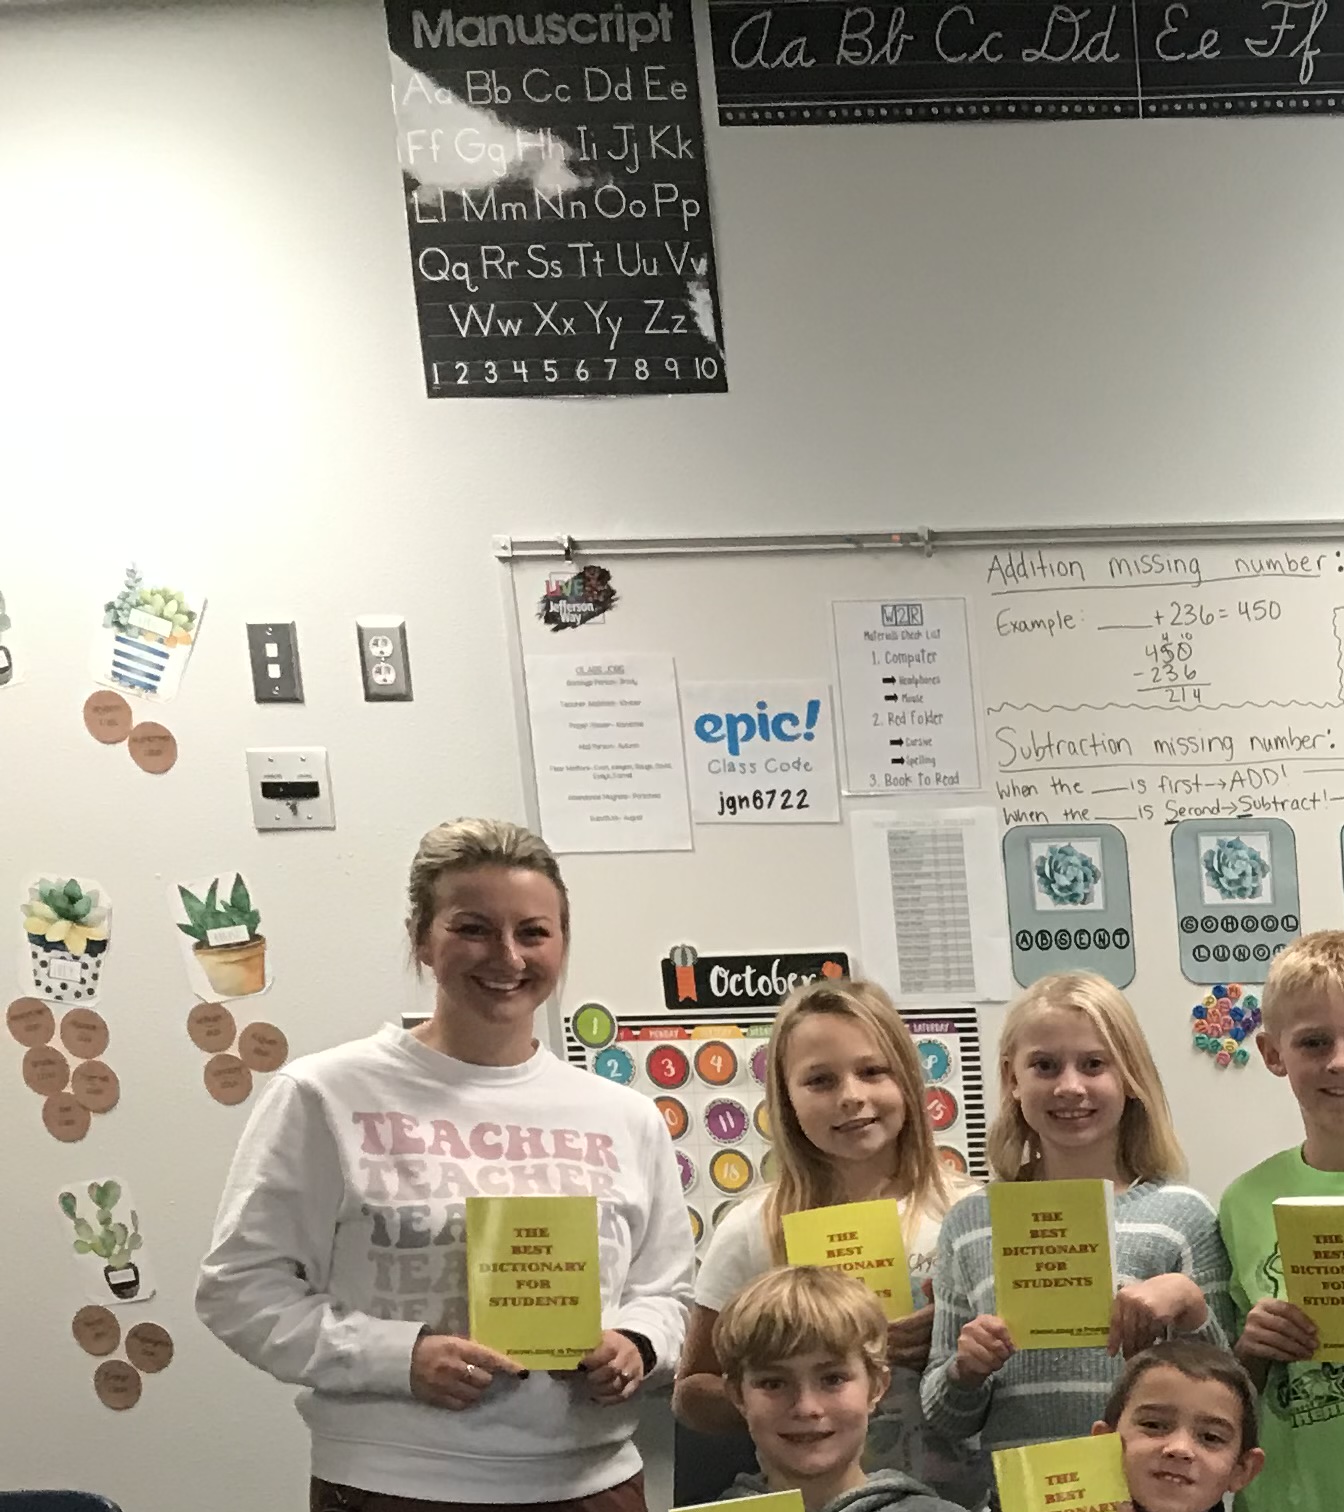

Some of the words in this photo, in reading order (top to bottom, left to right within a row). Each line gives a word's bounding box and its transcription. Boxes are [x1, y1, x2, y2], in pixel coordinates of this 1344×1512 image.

[412, 8, 674, 49] Manuscript
[731, 10, 812, 69] Aa
[836, 8, 914, 66] Bb
[935, 10, 1000, 64] Cc
[1023, 5, 1120, 62] Dd
[418, 247, 478, 291] Qq
[482, 246, 519, 276] Rr
[527, 246, 562, 278] Ss
[569, 244, 604, 275] Tt
[617, 244, 657, 275] Uu
[449, 305, 522, 336] Ww
[534, 302, 576, 336] Xx
[587, 301, 623, 349] Yy
[644, 300, 687, 334] Zz
[987, 551, 1086, 586] Addition
[1109, 553, 1201, 588] missing
[550, 600, 594, 612] Jefferson
[1239, 600, 1281, 621] 450
[560, 612, 581, 624] Way
[872, 651, 880, 665] 1.
[885, 649, 937, 667] Computer
[1166, 688, 1200, 702] 214
[694, 700, 820, 755] epic!
[873, 714, 883, 726] 2.
[888, 712, 906, 726] Red
[996, 726, 1132, 767] Subtraction
[1154, 735, 1234, 761] missing
[707, 759, 757, 775] Class
[765, 758, 813, 773] Code
[870, 774, 880, 787] 3.
[885, 773, 912, 786] Book
[936, 771, 959, 786] Read
[1050, 776, 1084, 794] the
[1129, 780, 1146, 794] is
[1158, 774, 1201, 794] first
[717, 789, 810, 815] jgn6722
[1063, 810, 1090, 821] the
[1138, 805, 1153, 819] is
[1016, 929, 1130, 950] ABSENT
[709, 966, 818, 997] October
[607, 1060, 622, 1078] 2
[662, 1059, 675, 1076] 3
[710, 1055, 723, 1073] 4
[719, 1112, 736, 1131] 11
[352, 1112, 622, 1173] TEACHER
[513, 1227, 549, 1238] THE
[511, 1245, 553, 1255] BEST
[479, 1262, 586, 1272] DICTIONARY
[516, 1279, 550, 1289] FOR
[489, 1296, 579, 1307] STUDENTS
